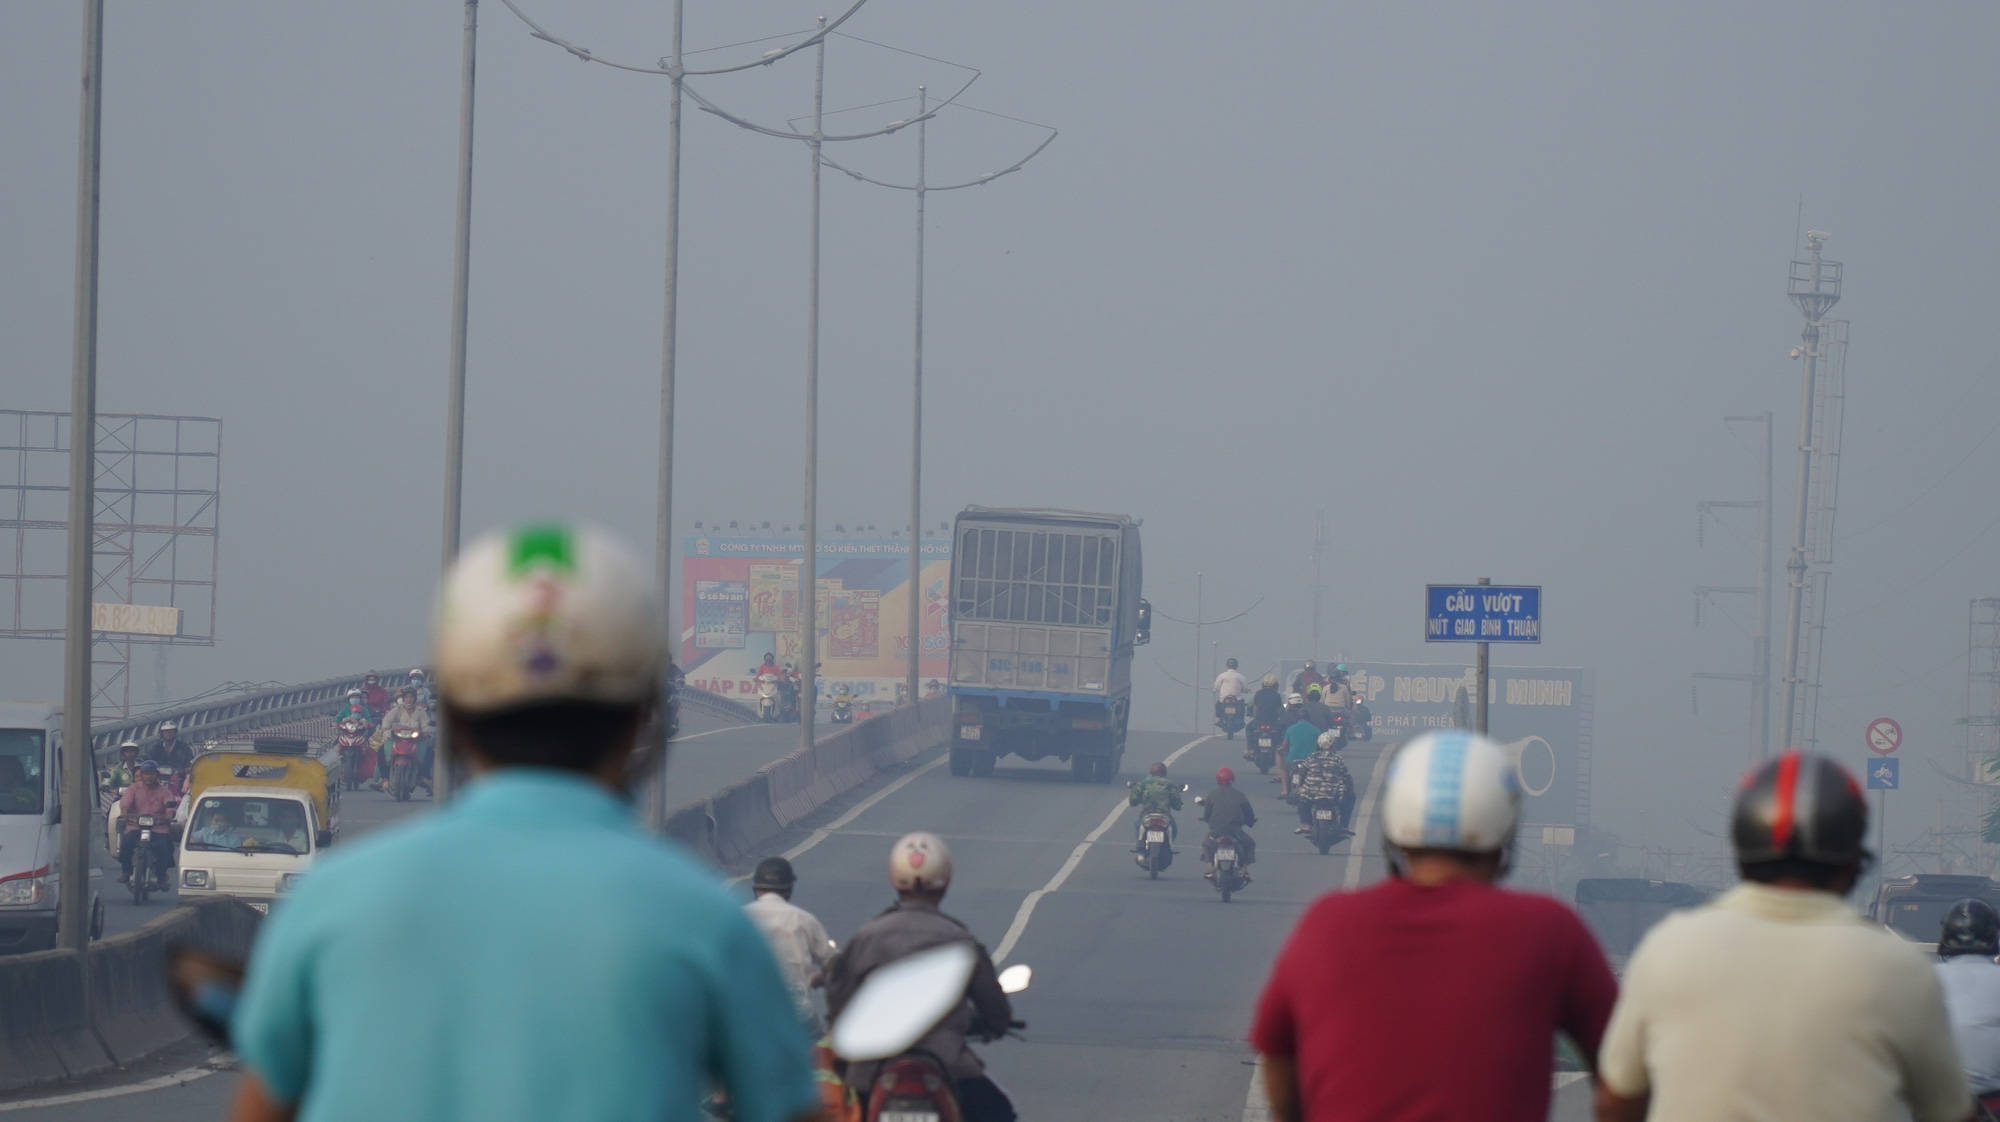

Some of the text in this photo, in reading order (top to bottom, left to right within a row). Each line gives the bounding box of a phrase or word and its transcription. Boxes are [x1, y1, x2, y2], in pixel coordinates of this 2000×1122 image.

[720, 541, 748, 552] CÔNG
[750, 544, 760, 552] TY
[761, 544, 786, 552] TNHH
[1446, 589, 1522, 616] CẦU VƯỢT
[1429, 613, 1537, 640] NÚT GIAO BÌNH THUẬN
[1506, 679, 1572, 706] MINH
[1387, 713, 1417, 727] PHÁT
[1422, 712, 1456, 728] TRIỂN
